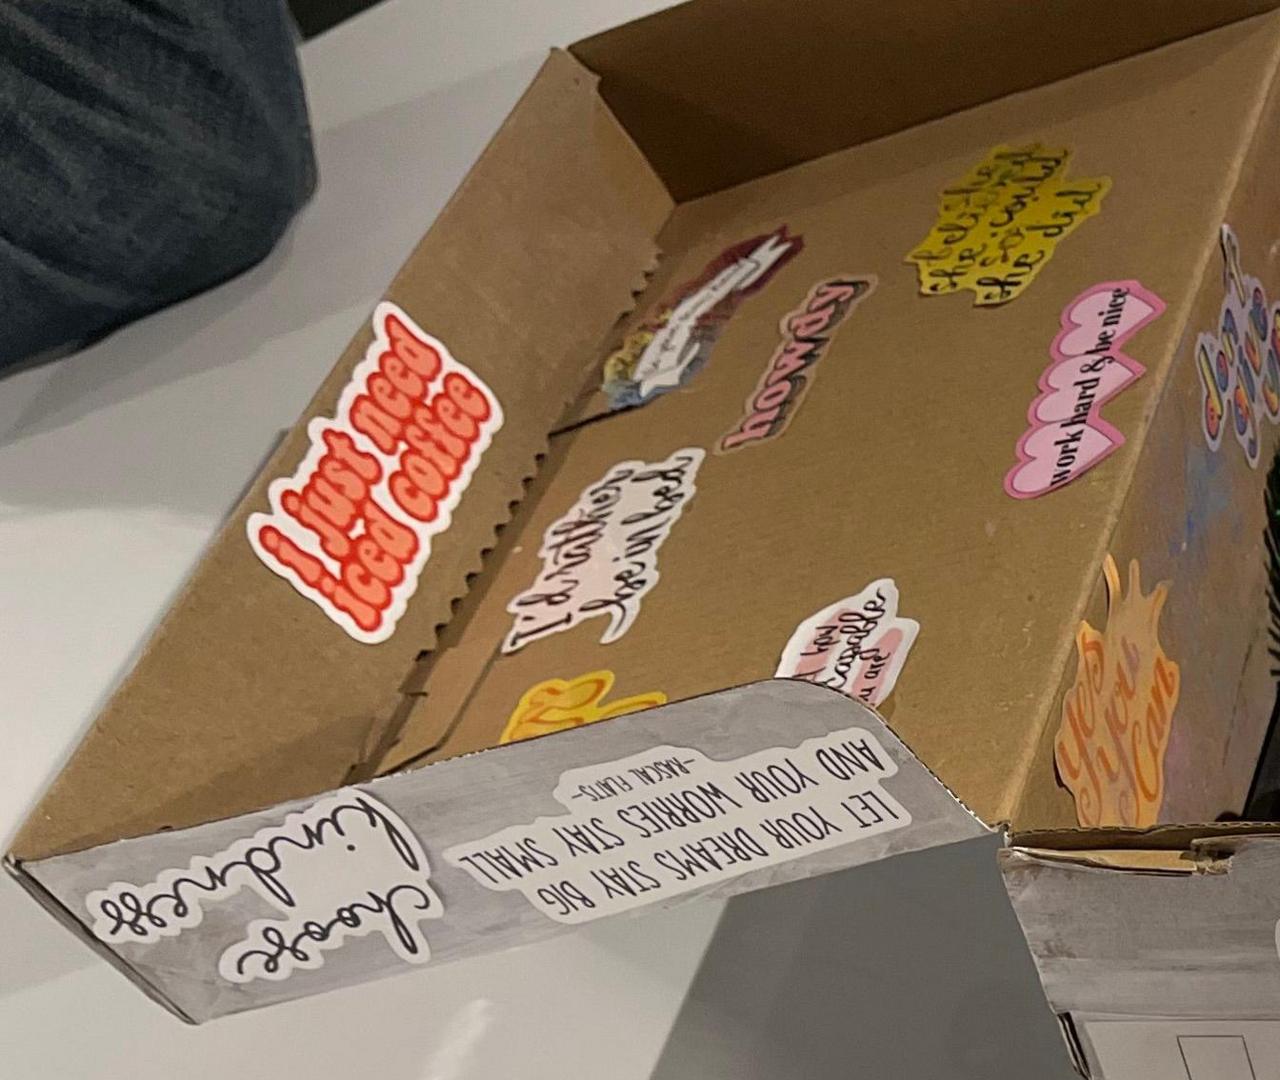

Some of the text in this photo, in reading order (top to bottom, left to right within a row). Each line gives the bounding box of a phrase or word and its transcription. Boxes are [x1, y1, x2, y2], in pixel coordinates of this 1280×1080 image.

[721, 279, 870, 450] howdy
[1050, 287, 1130, 487] work hard & be nice
[281, 428, 383, 563] just
[351, 314, 442, 456] need
[318, 371, 492, 633] iced coffee
[620, 456, 693, 525] bed
[509, 579, 579, 646] I'd
[544, 468, 636, 582] rather
[578, 561, 648, 638] be
[612, 517, 672, 563] in
[800, 625, 839, 656] how
[824, 589, 886, 688] capable
[860, 645, 892, 681] are
[100, 797, 419, 936] kindness
[458, 739, 885, 884] AND YOUR WORRIES STAY SMALL
[537, 790, 900, 915] LET YOUR DREAMS STAY BIG
